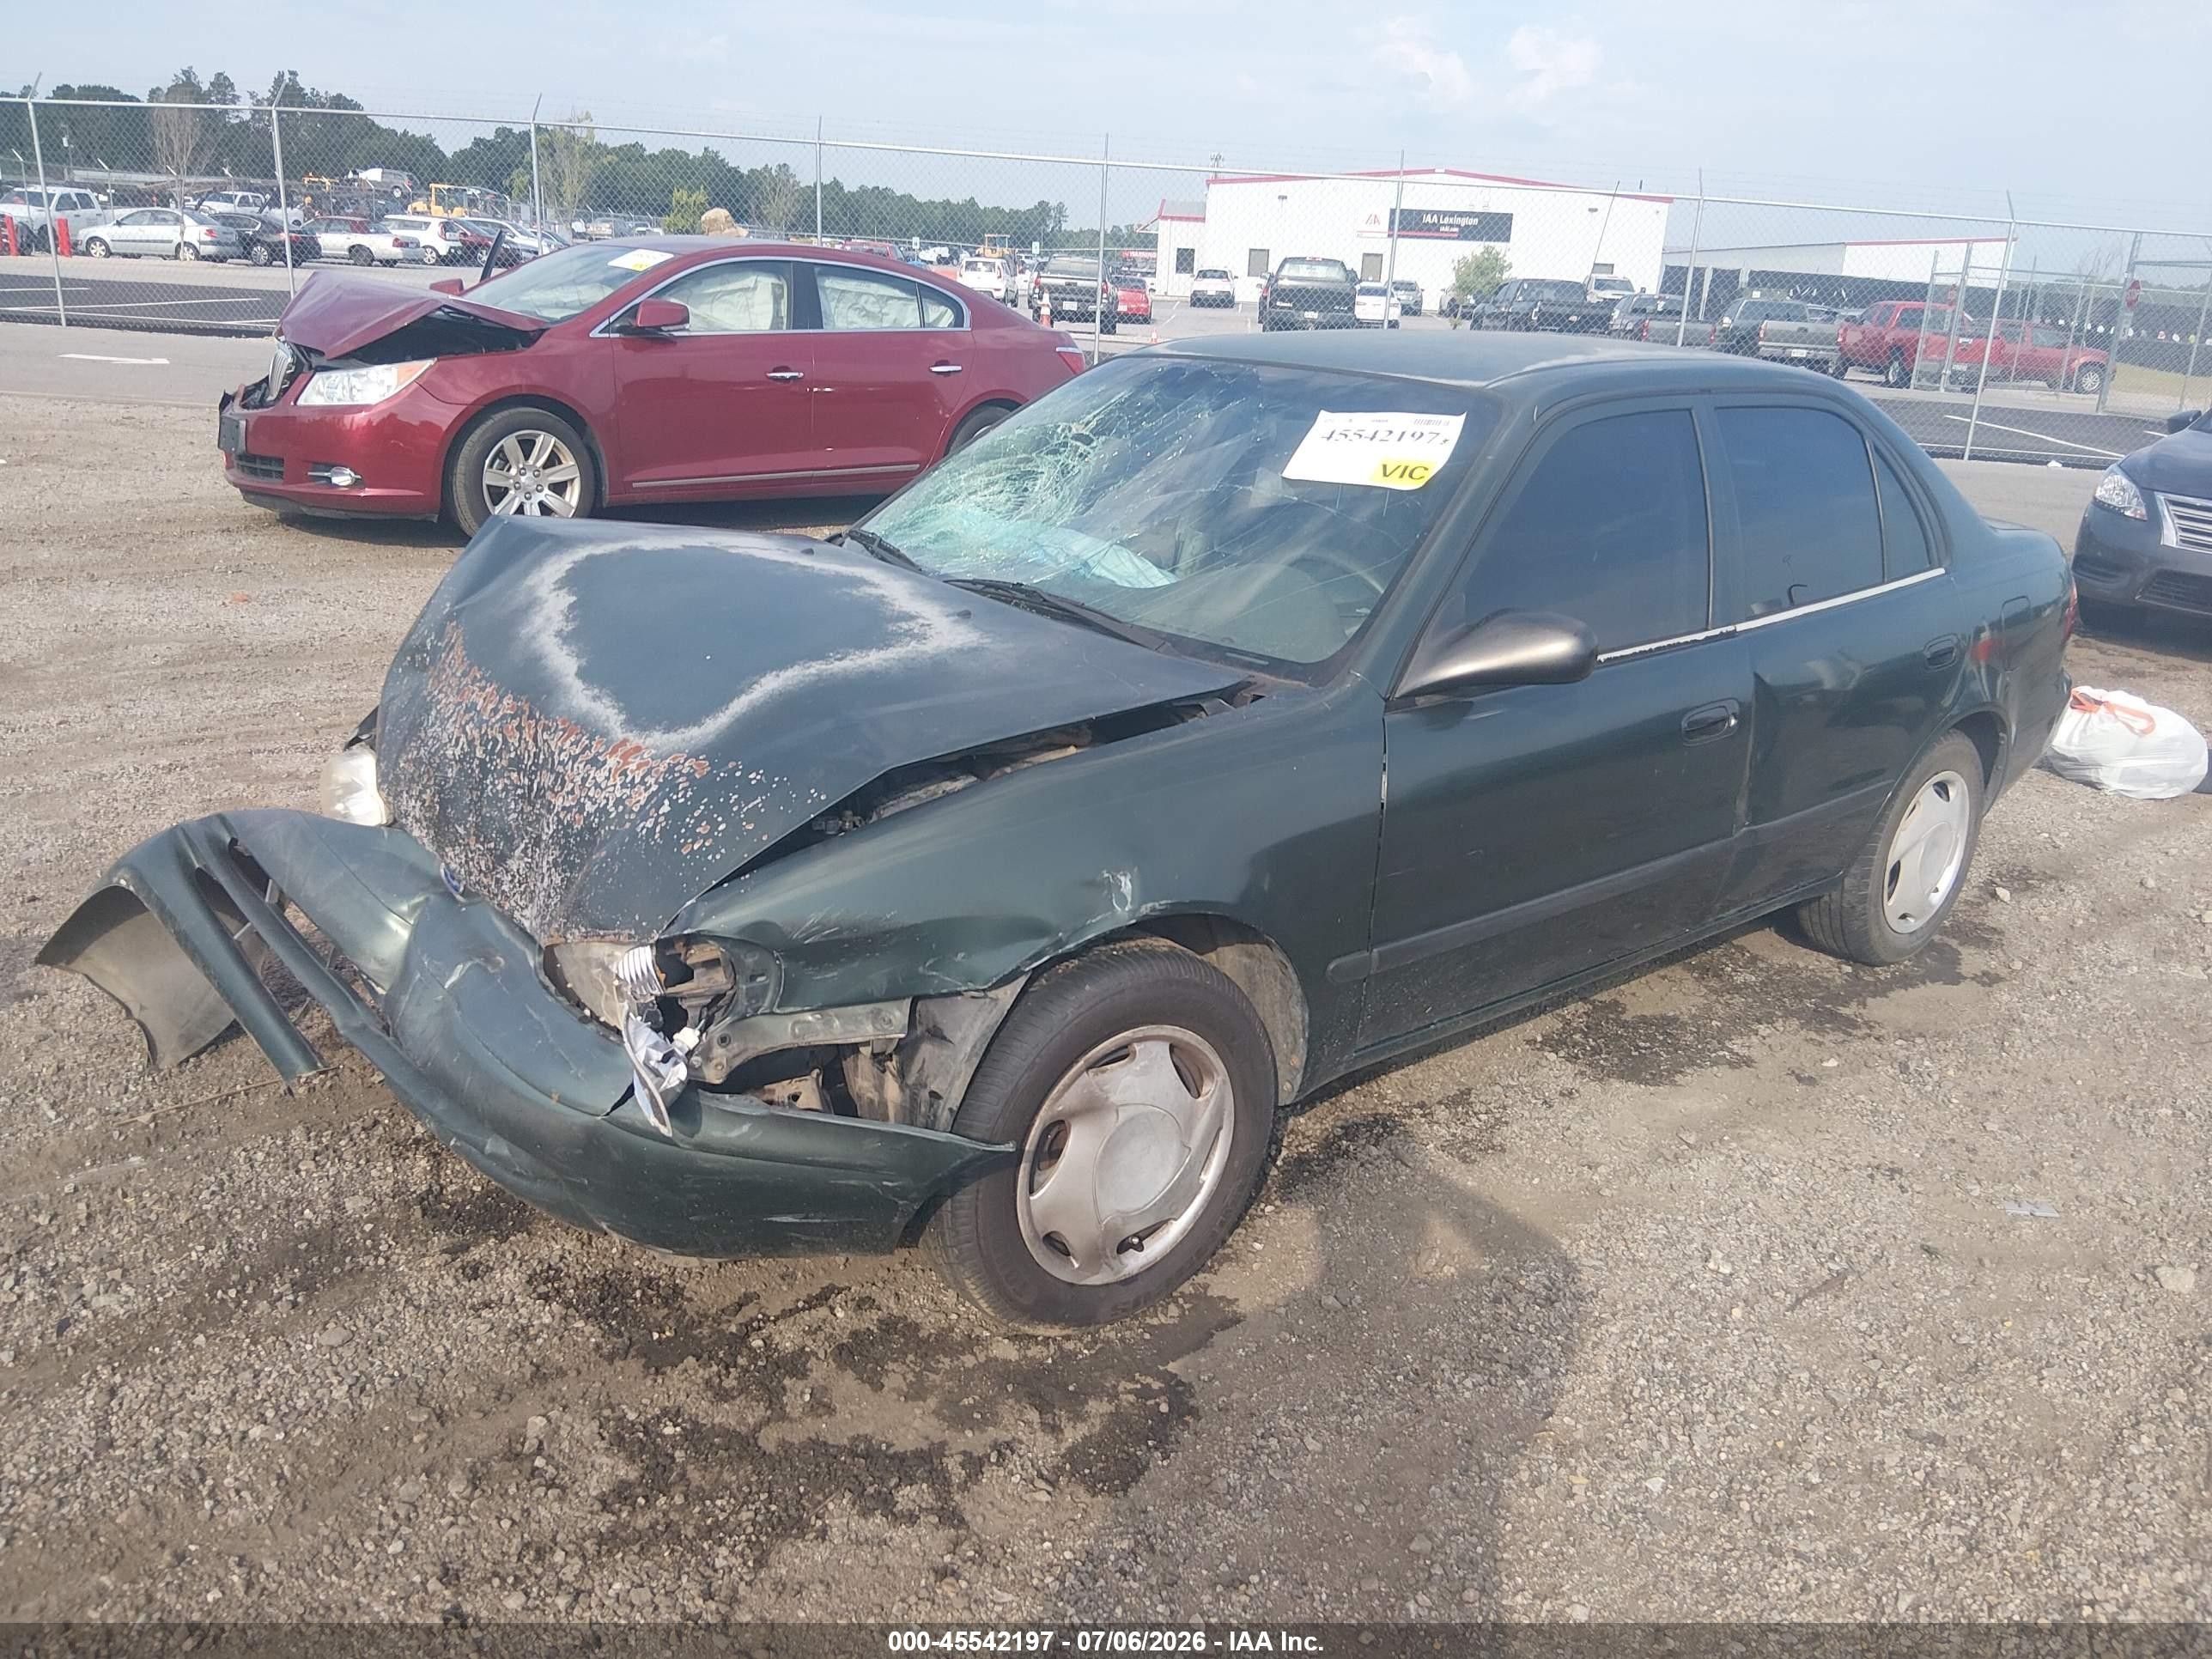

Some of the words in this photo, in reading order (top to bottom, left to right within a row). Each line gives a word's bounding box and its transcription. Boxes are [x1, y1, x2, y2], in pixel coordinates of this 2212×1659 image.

[1422, 213, 1438, 224] IAA
[1439, 214, 1479, 228] Lexington
[1381, 464, 1429, 480] VIC
